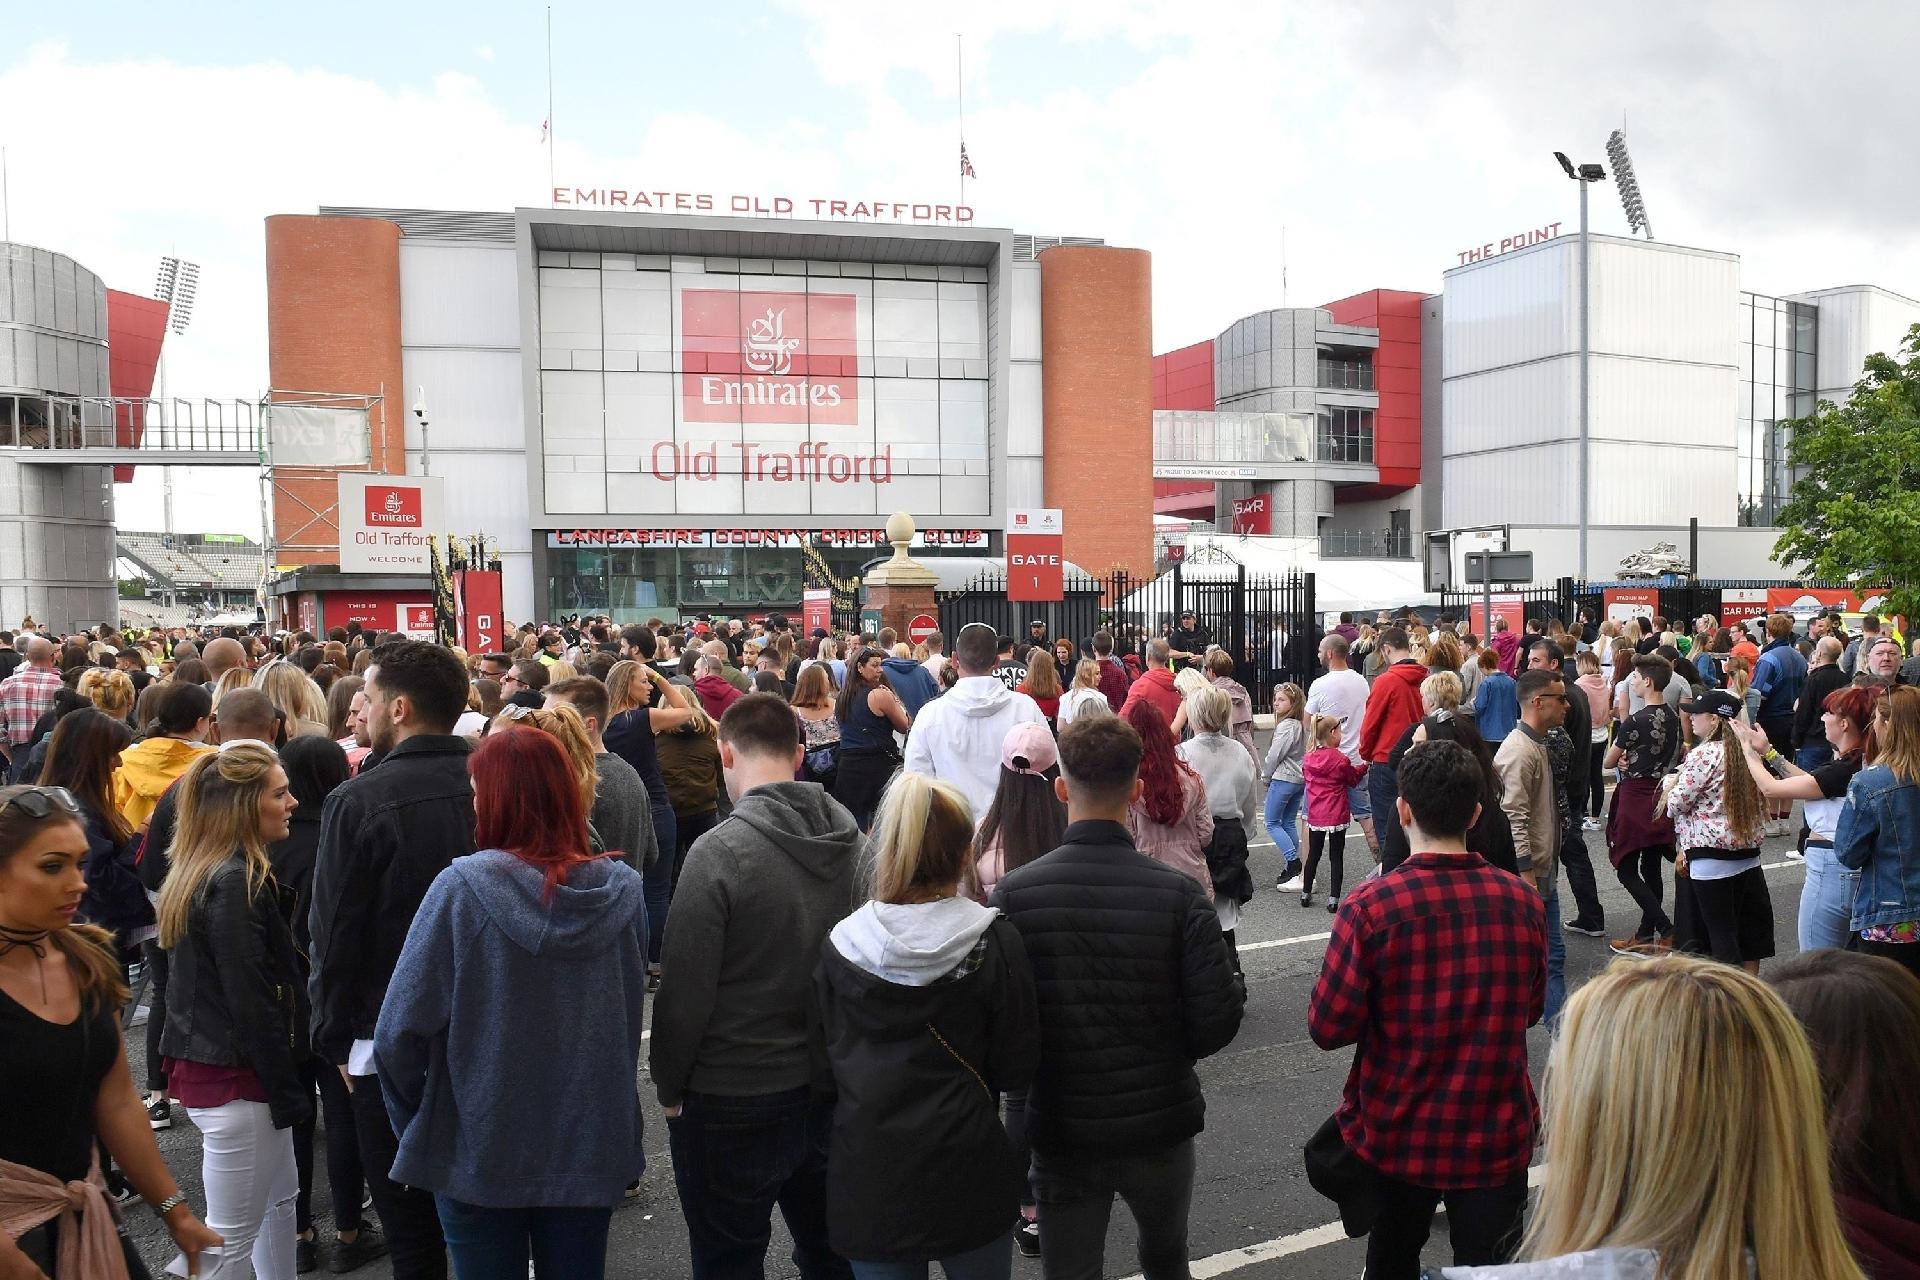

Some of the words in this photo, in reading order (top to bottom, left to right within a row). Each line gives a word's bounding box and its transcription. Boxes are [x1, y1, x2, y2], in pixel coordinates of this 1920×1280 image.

[553, 187, 713, 210] EMIRATES
[731, 195, 793, 213] OLD
[808, 199, 974, 222] TRAFFORD
[1457, 243, 1495, 265] THE
[1500, 221, 1562, 252] POINT
[701, 375, 841, 407] Emirates
[652, 440, 717, 482] Old
[732, 441, 892, 484] Trafford
[371, 512, 416, 523] Emirates
[355, 531, 377, 545] Old
[555, 528, 703, 543] LANCASHIRE
[715, 528, 810, 543] COUNTY
[821, 528, 887, 543] CRICK
[925, 529, 982, 543] CLUB
[368, 556, 423, 564] WELCOME
[1012, 554, 1060, 566] GATE
[1033, 576, 1038, 589] 1
[1723, 607, 1742, 615] CAR
[865, 619, 878, 634] BG1
[992, 666, 1028, 678] OKYO
